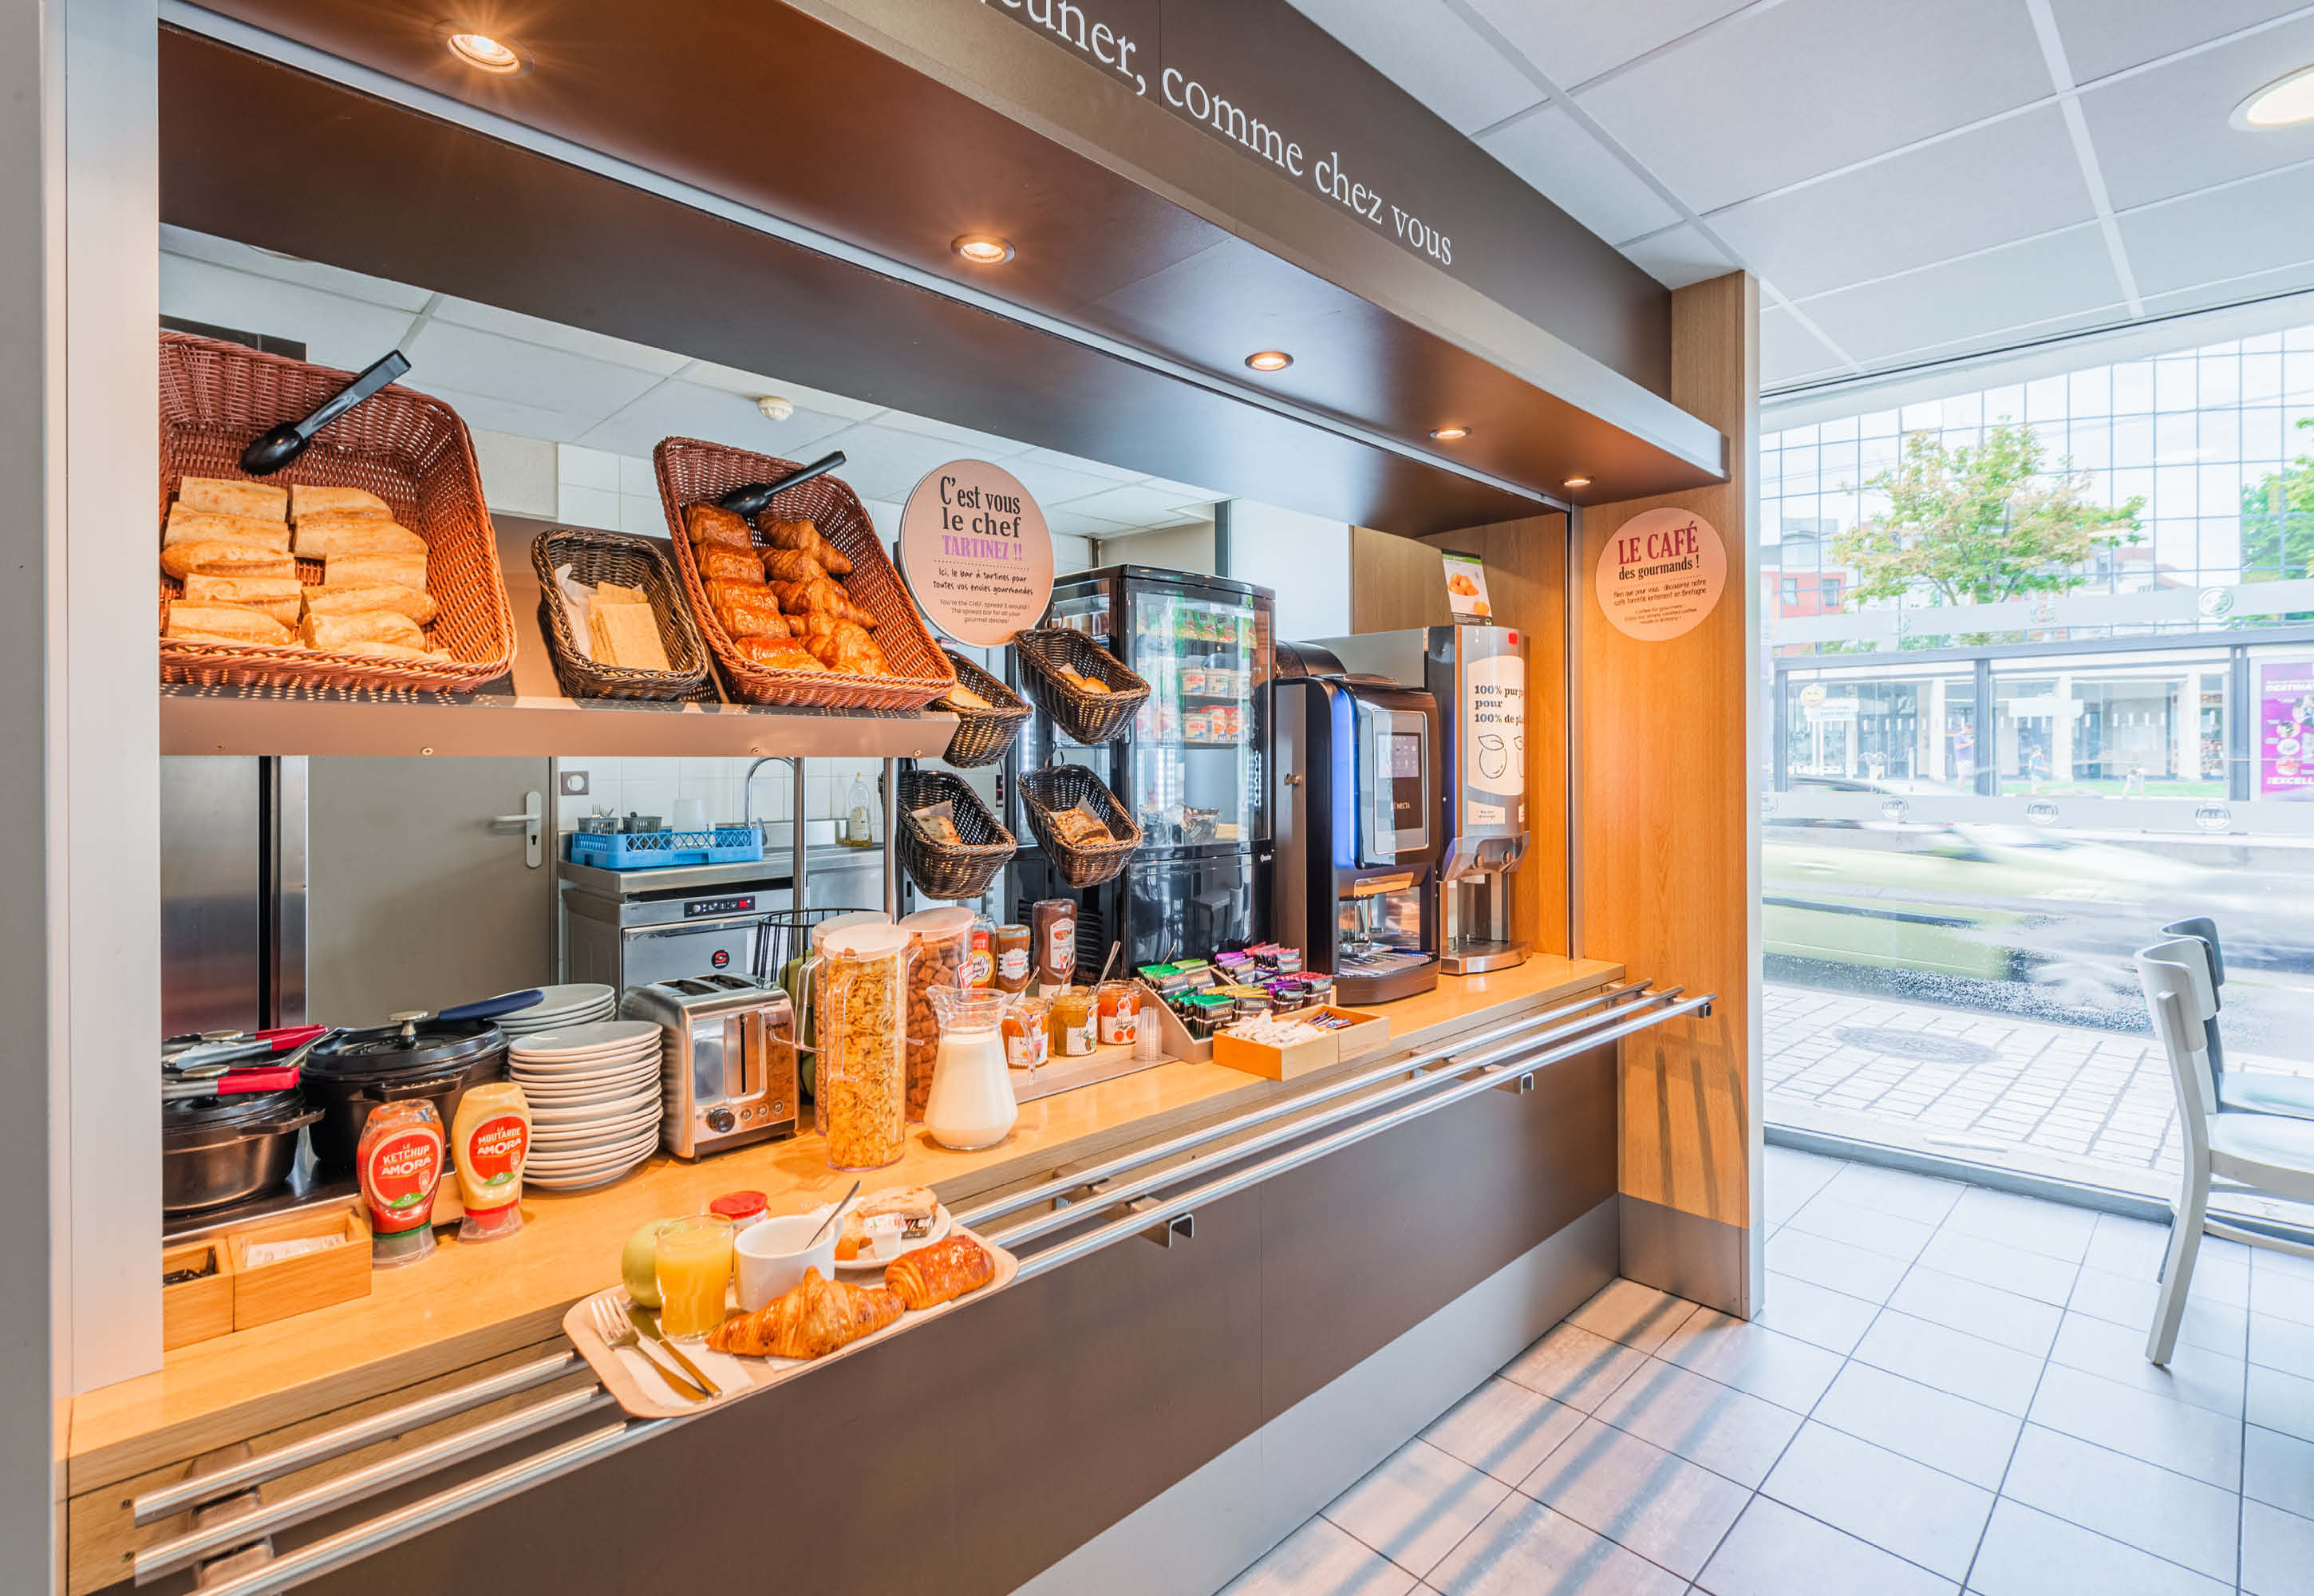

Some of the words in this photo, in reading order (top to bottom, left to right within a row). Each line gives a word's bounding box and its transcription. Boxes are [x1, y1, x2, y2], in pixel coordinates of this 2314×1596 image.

[1000, 0, 1147, 96] uner,
[1162, 67, 1304, 177] comme
[1314, 151, 1383, 225] chez
[1391, 203, 1451, 266] vous
[940, 476, 981, 509] C'est
[985, 493, 1021, 515] vous
[942, 506, 964, 531] le
[972, 512, 1021, 538] chef
[941, 535, 1009, 560] TARTINEZ
[1013, 543, 1022, 561] !!
[1617, 536, 1641, 565] LE
[1647, 520, 1699, 559] CAFÉ
[951, 568, 958, 577] le
[960, 569, 973, 579] bar
[983, 571, 1009, 582] tartines
[1012, 575, 1027, 585] pour
[1618, 566, 1635, 581] des
[1637, 556, 1693, 581] gourmands
[933, 580, 954, 591] toutes
[970, 583, 990, 593] envies
[993, 587, 1033, 596] gourmandes
[1475, 685, 1503, 696] 100%
[1504, 688, 1518, 698] pur
[1475, 700, 1503, 710] pour
[1475, 713, 1503, 724] 100%
[1504, 714, 1514, 724] de
[1396, 801, 1411, 810] NECTA
[477, 1126, 522, 1145] MOUTARDE
[382, 1144, 431, 1165] KETCHUP
[476, 1137, 523, 1156] AMORA
[381, 1156, 432, 1175] AMORA
